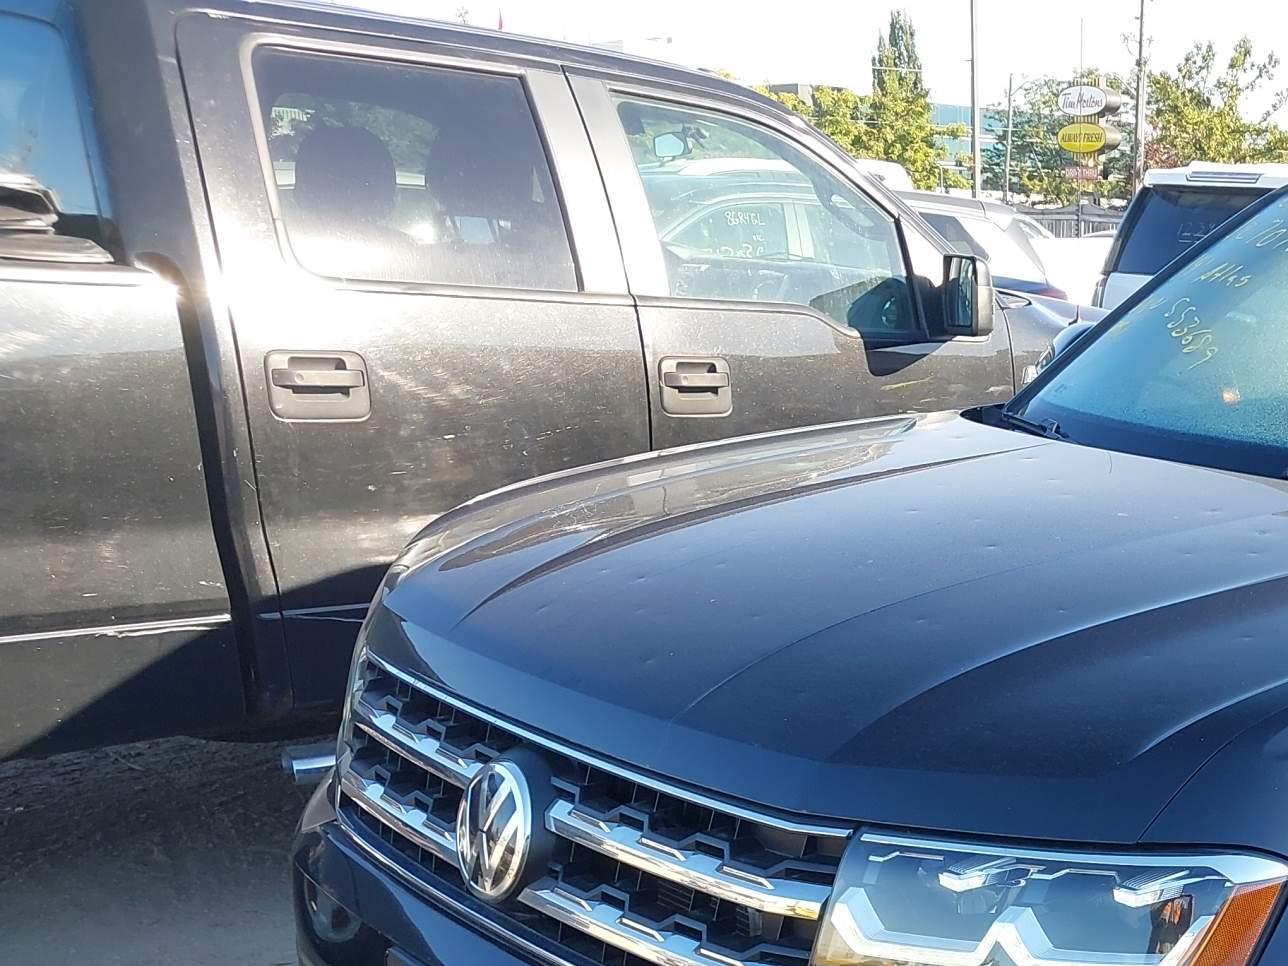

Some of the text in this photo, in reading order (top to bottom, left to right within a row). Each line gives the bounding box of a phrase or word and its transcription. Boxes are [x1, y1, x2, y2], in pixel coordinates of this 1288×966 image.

[1062, 91, 1103, 109] Tim Hortons
[1083, 132, 1103, 143] FRESH
